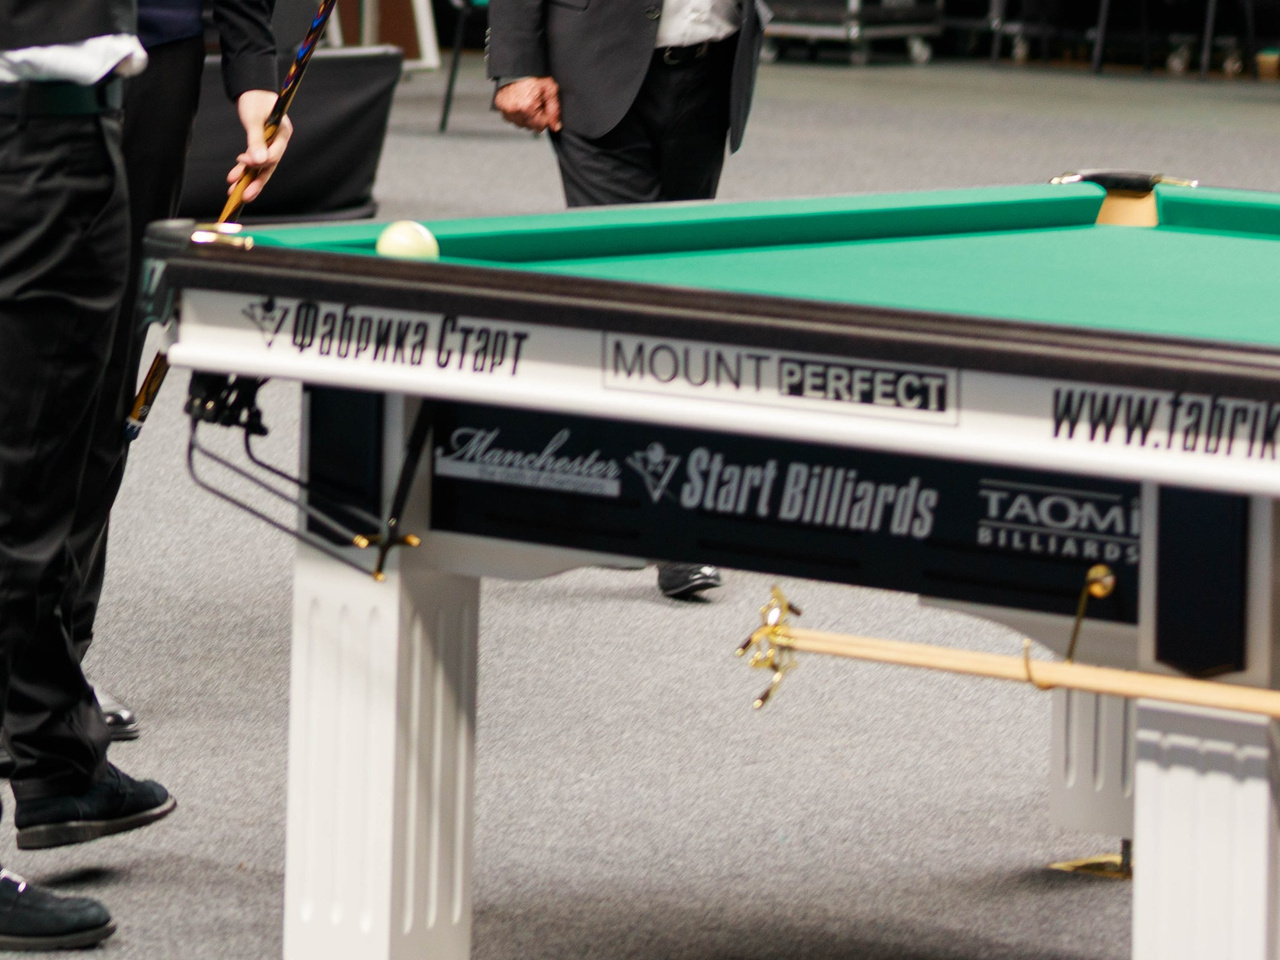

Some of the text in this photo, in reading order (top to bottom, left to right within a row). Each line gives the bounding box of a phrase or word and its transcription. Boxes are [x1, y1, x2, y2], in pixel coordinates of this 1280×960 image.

[292, 301, 530, 377] Фабрика Старт
[612, 342, 946, 412] MOUNT PERFECT
[434, 427, 621, 480] Manchester
[682, 445, 939, 540] Start Billiards
[977, 526, 1140, 565] BILLIARDS
